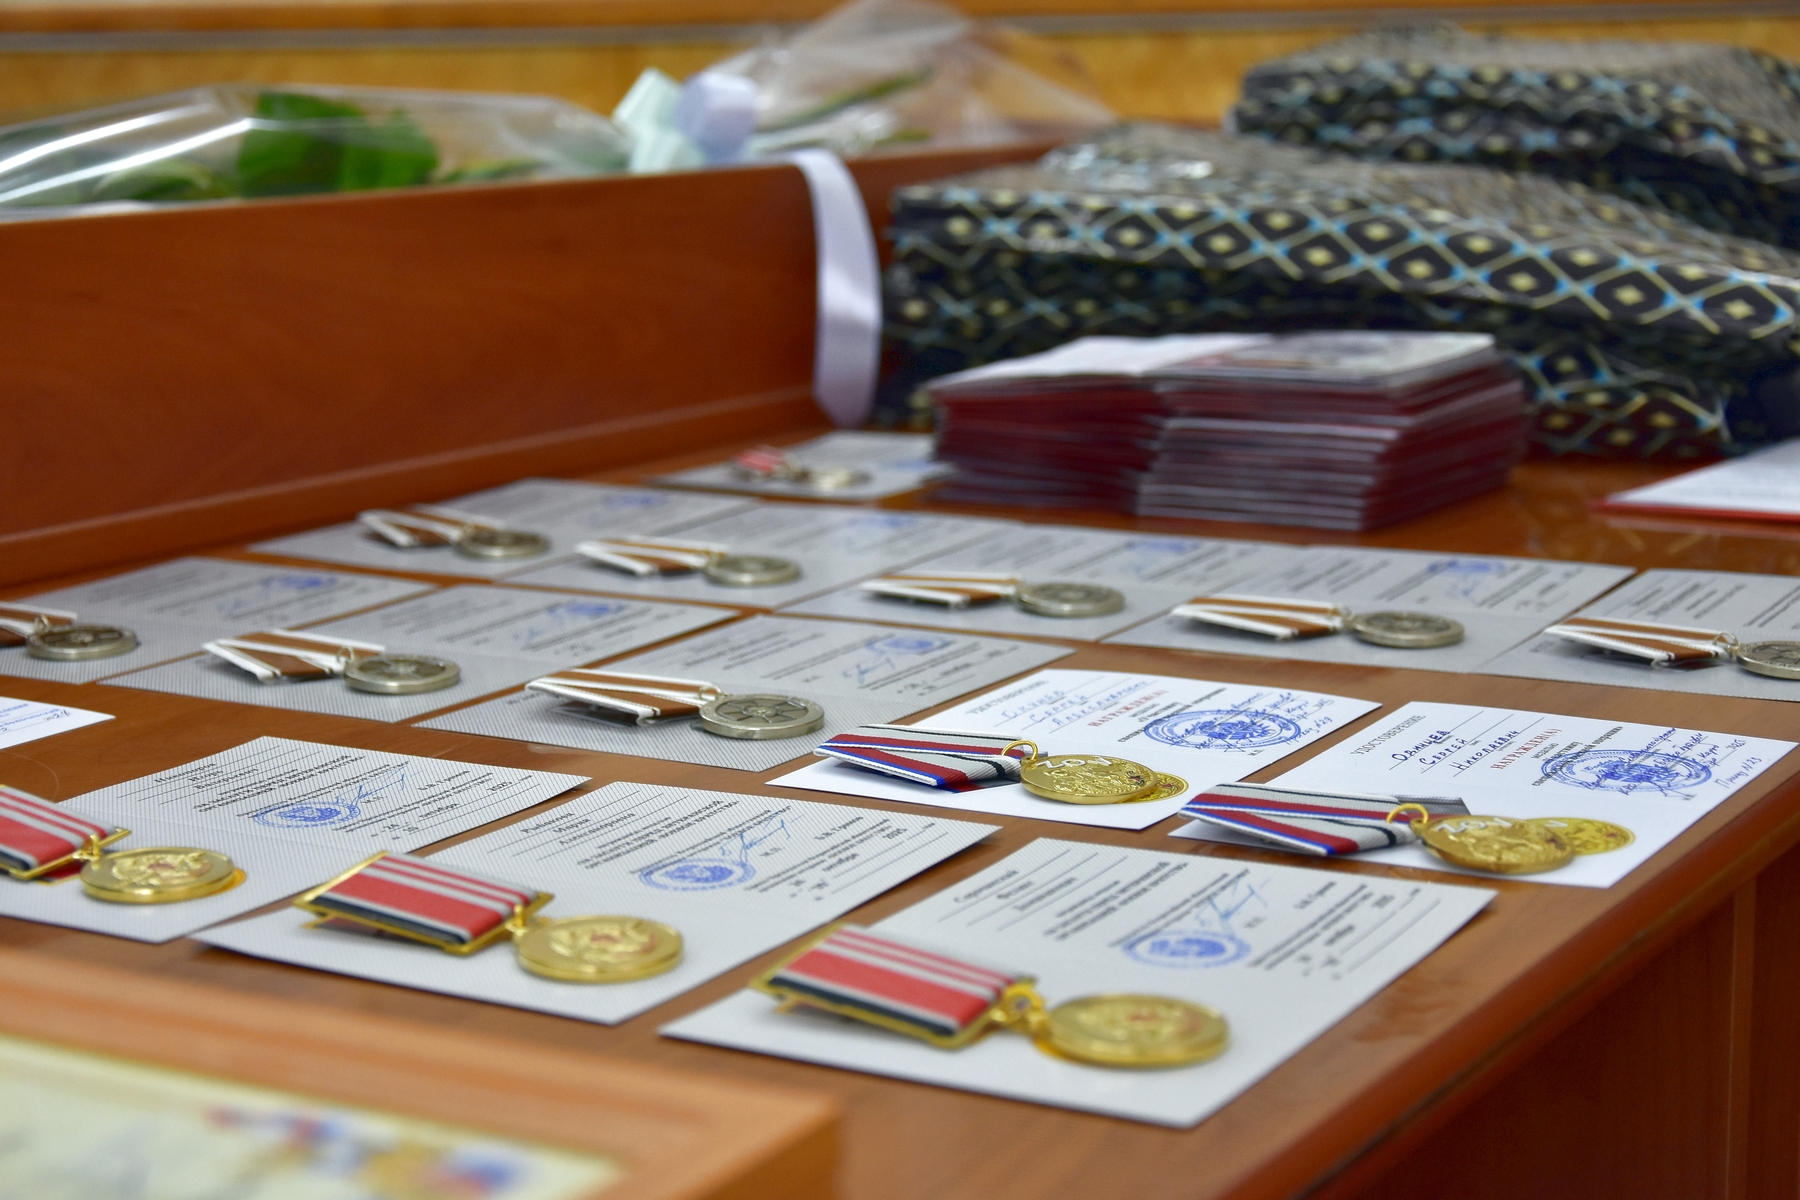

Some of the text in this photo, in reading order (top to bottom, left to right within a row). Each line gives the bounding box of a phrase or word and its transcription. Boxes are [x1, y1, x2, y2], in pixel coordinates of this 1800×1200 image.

[1352, 714, 1425, 755] УДОСТОВЕРЕНИЕ
[1419, 737, 1468, 765] Сергей
[1450, 729, 1520, 770] Николаевич
[1490, 728, 1559, 769] НАГРАЖДЕН(А)
